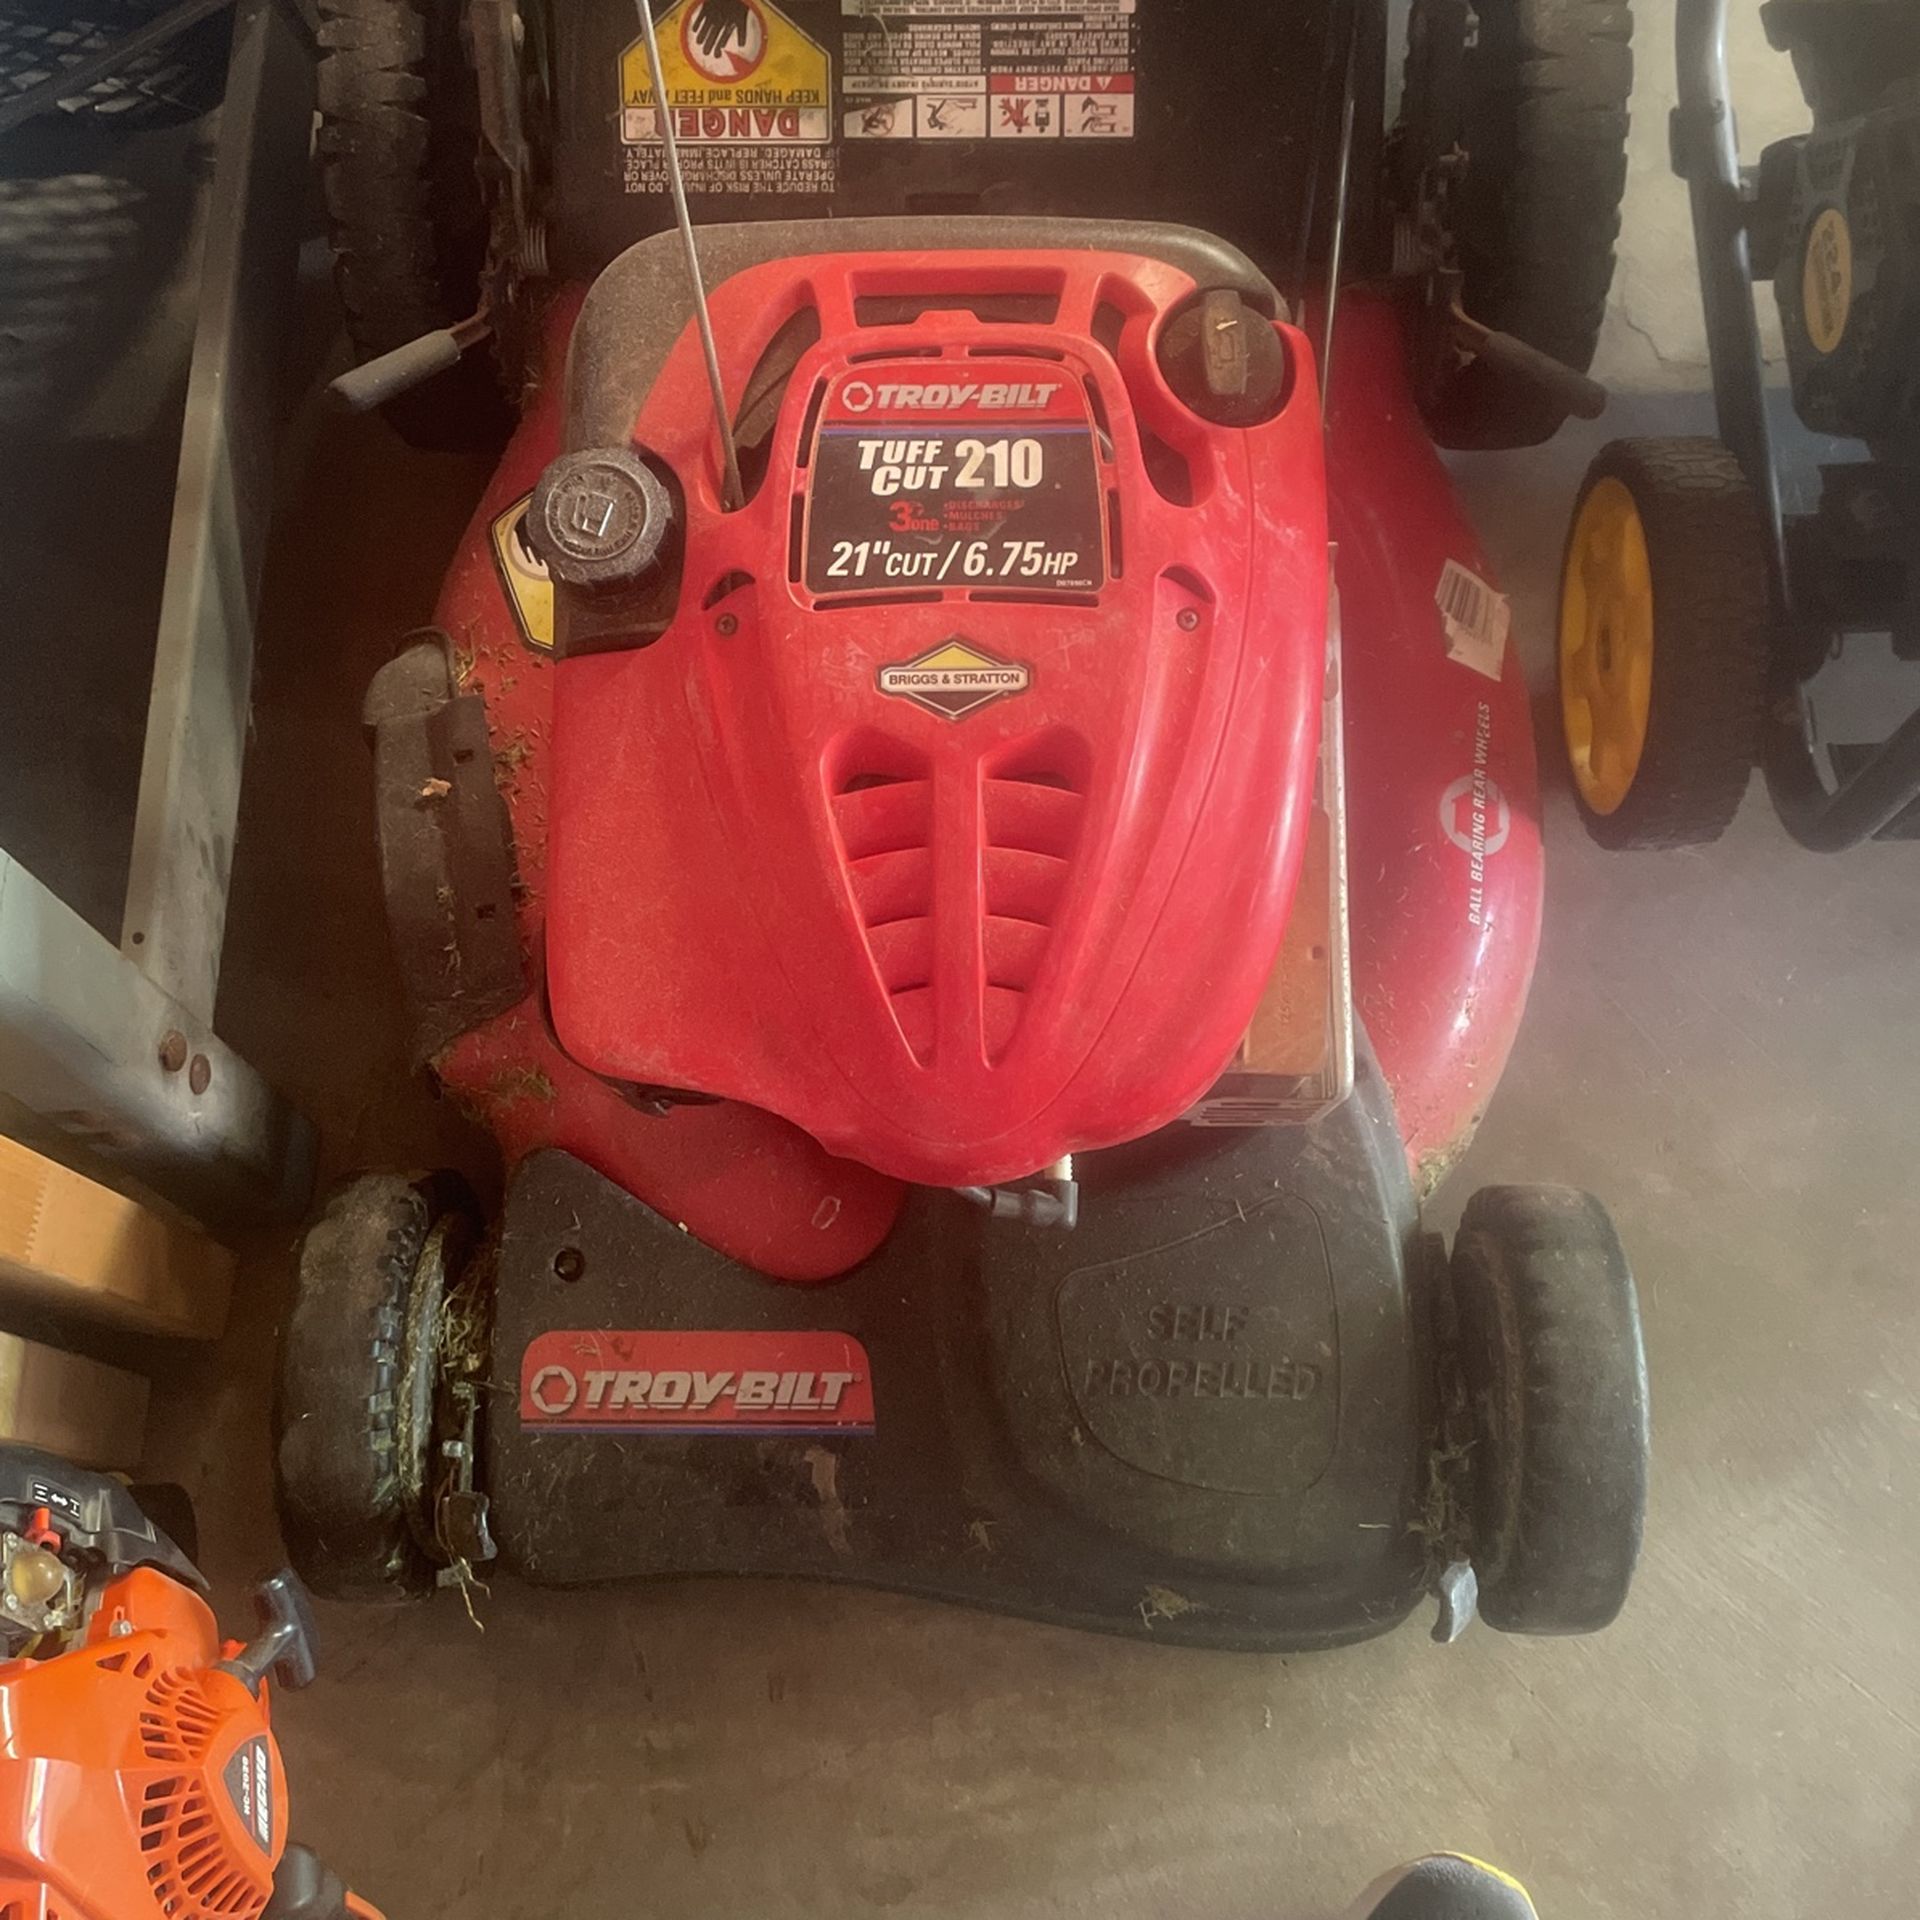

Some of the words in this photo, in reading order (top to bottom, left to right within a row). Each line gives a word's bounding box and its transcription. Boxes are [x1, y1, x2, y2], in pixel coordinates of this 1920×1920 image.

[1015, 76, 1091, 91] DANGER
[673, 89, 704, 103] FEET
[708, 89, 731, 103] and
[736, 89, 782, 103] HANDS
[786, 89, 819, 103] KEEP
[739, 159, 748, 170] IS
[752, 159, 800, 170] CATCHER
[624, 171, 638, 181] OR
[740, 171, 781, 181] UNLESS
[785, 171, 835, 181] OPERATE
[625, 182, 645, 193] NOT
[648, 182, 662, 193] DO
[710, 182, 722, 193] OF
[726, 182, 749, 193] RISK
[754, 182, 772, 193] THE
[777, 182, 817, 193] REDUCE
[821, 182, 835, 193] TO
[876, 383, 1058, 409] TROY-BILT
[858, 440, 943, 470] TUFF
[954, 438, 1043, 488] 210
[871, 465, 949, 496] CUT
[888, 673, 939, 686] BRIGGS
[941, 674, 951, 685] &
[953, 672, 1020, 685] STRATTON
[1473, 702, 1491, 765] WHEELS
[1472, 769, 1487, 810] REAR
[1470, 812, 1486, 882] BEARING
[1468, 886, 1483, 926] BALL
[1148, 1304, 1250, 1342] SELF
[1082, 1357, 1323, 1401] PROPELLED
[582, 1370, 855, 1411] TROY-BILT
